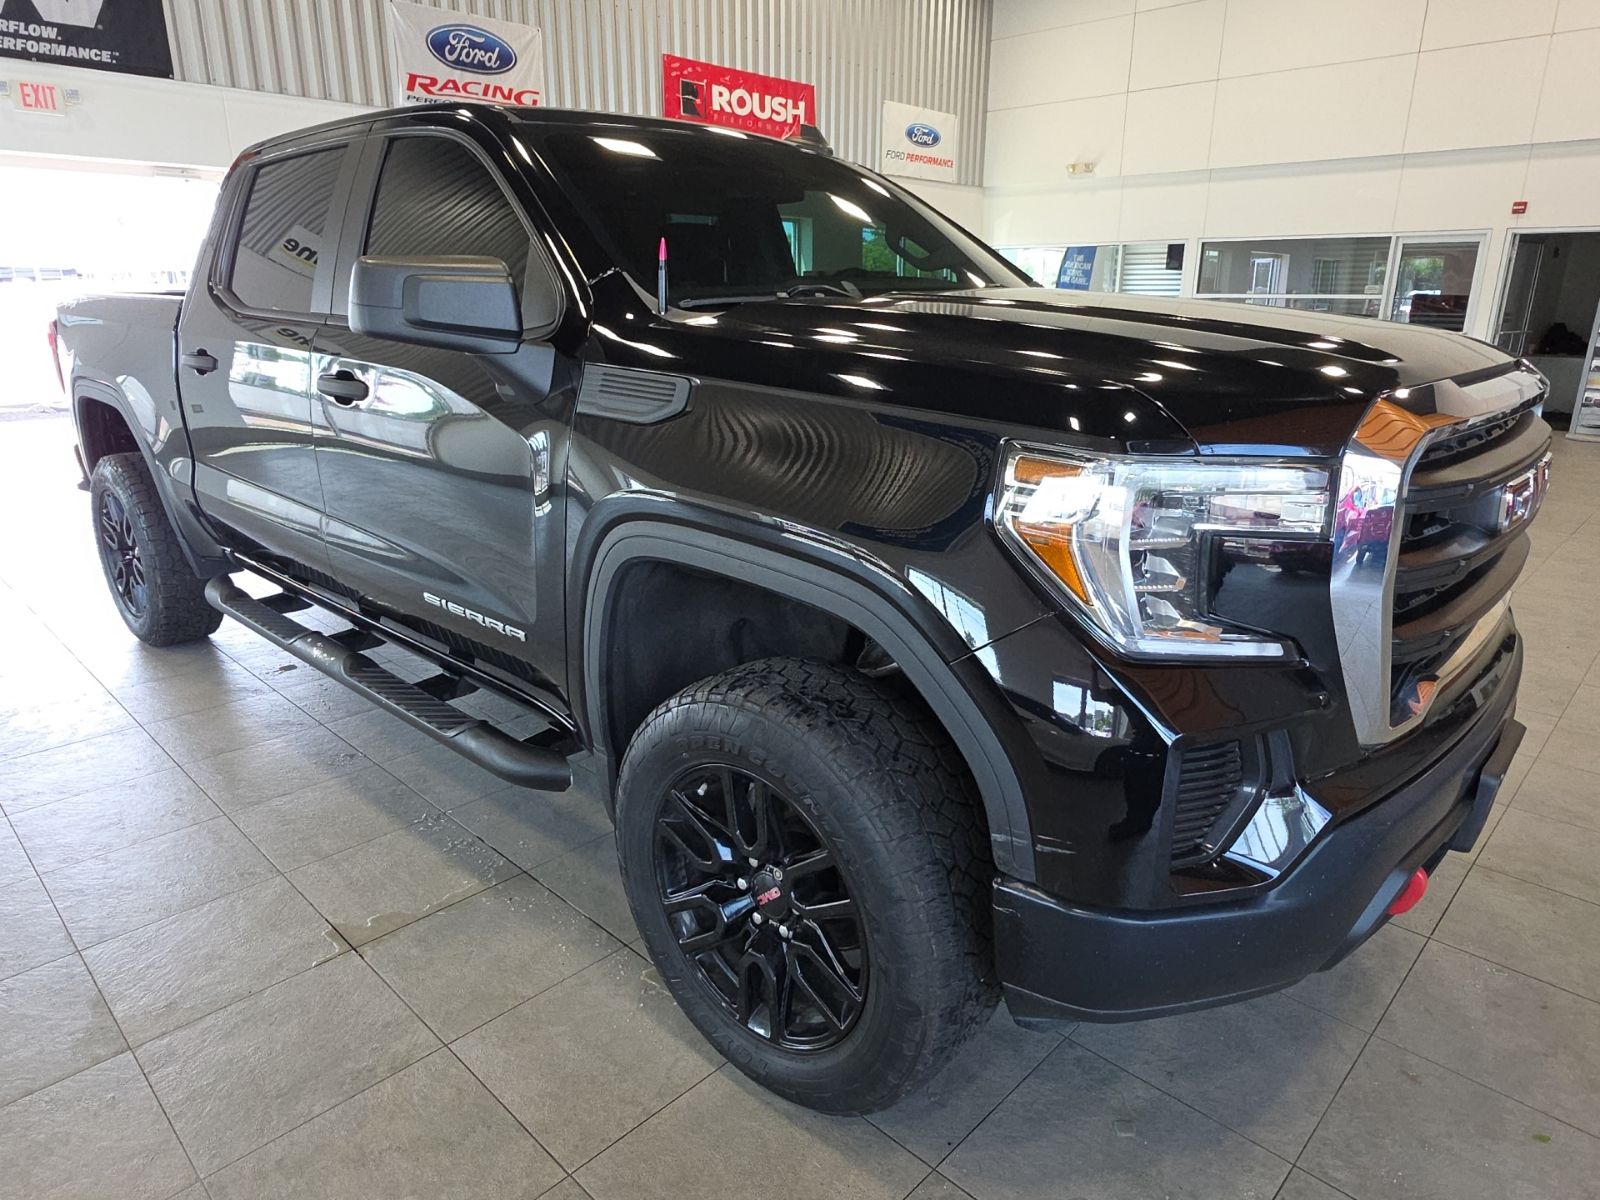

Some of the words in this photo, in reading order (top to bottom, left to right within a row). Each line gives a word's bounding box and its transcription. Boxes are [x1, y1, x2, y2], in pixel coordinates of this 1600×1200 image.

[444, 31, 500, 69] Ford
[19, 82, 57, 110] EXIT
[406, 72, 540, 106] RACING
[711, 84, 806, 125] ROUSH
[911, 126, 934, 145] Ford
[885, 150, 905, 161] FORD
[422, 591, 527, 642] SIERRA
